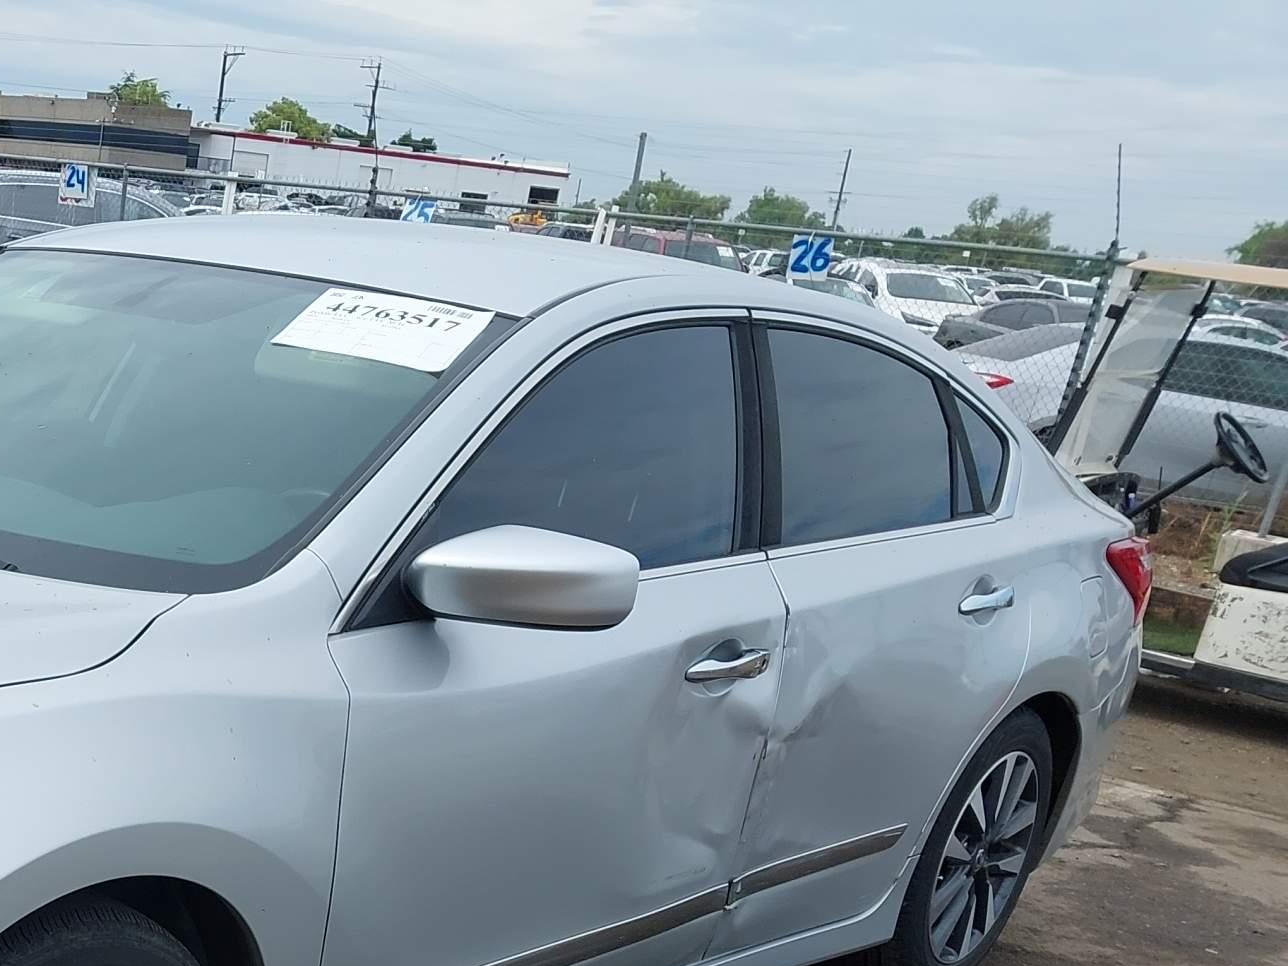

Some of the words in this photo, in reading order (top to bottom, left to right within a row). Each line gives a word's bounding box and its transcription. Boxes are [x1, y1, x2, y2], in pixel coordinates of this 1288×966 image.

[66, 165, 86, 193] 24
[401, 198, 435, 223] 25
[790, 237, 832, 273] 26
[326, 302, 462, 332] 44763517
